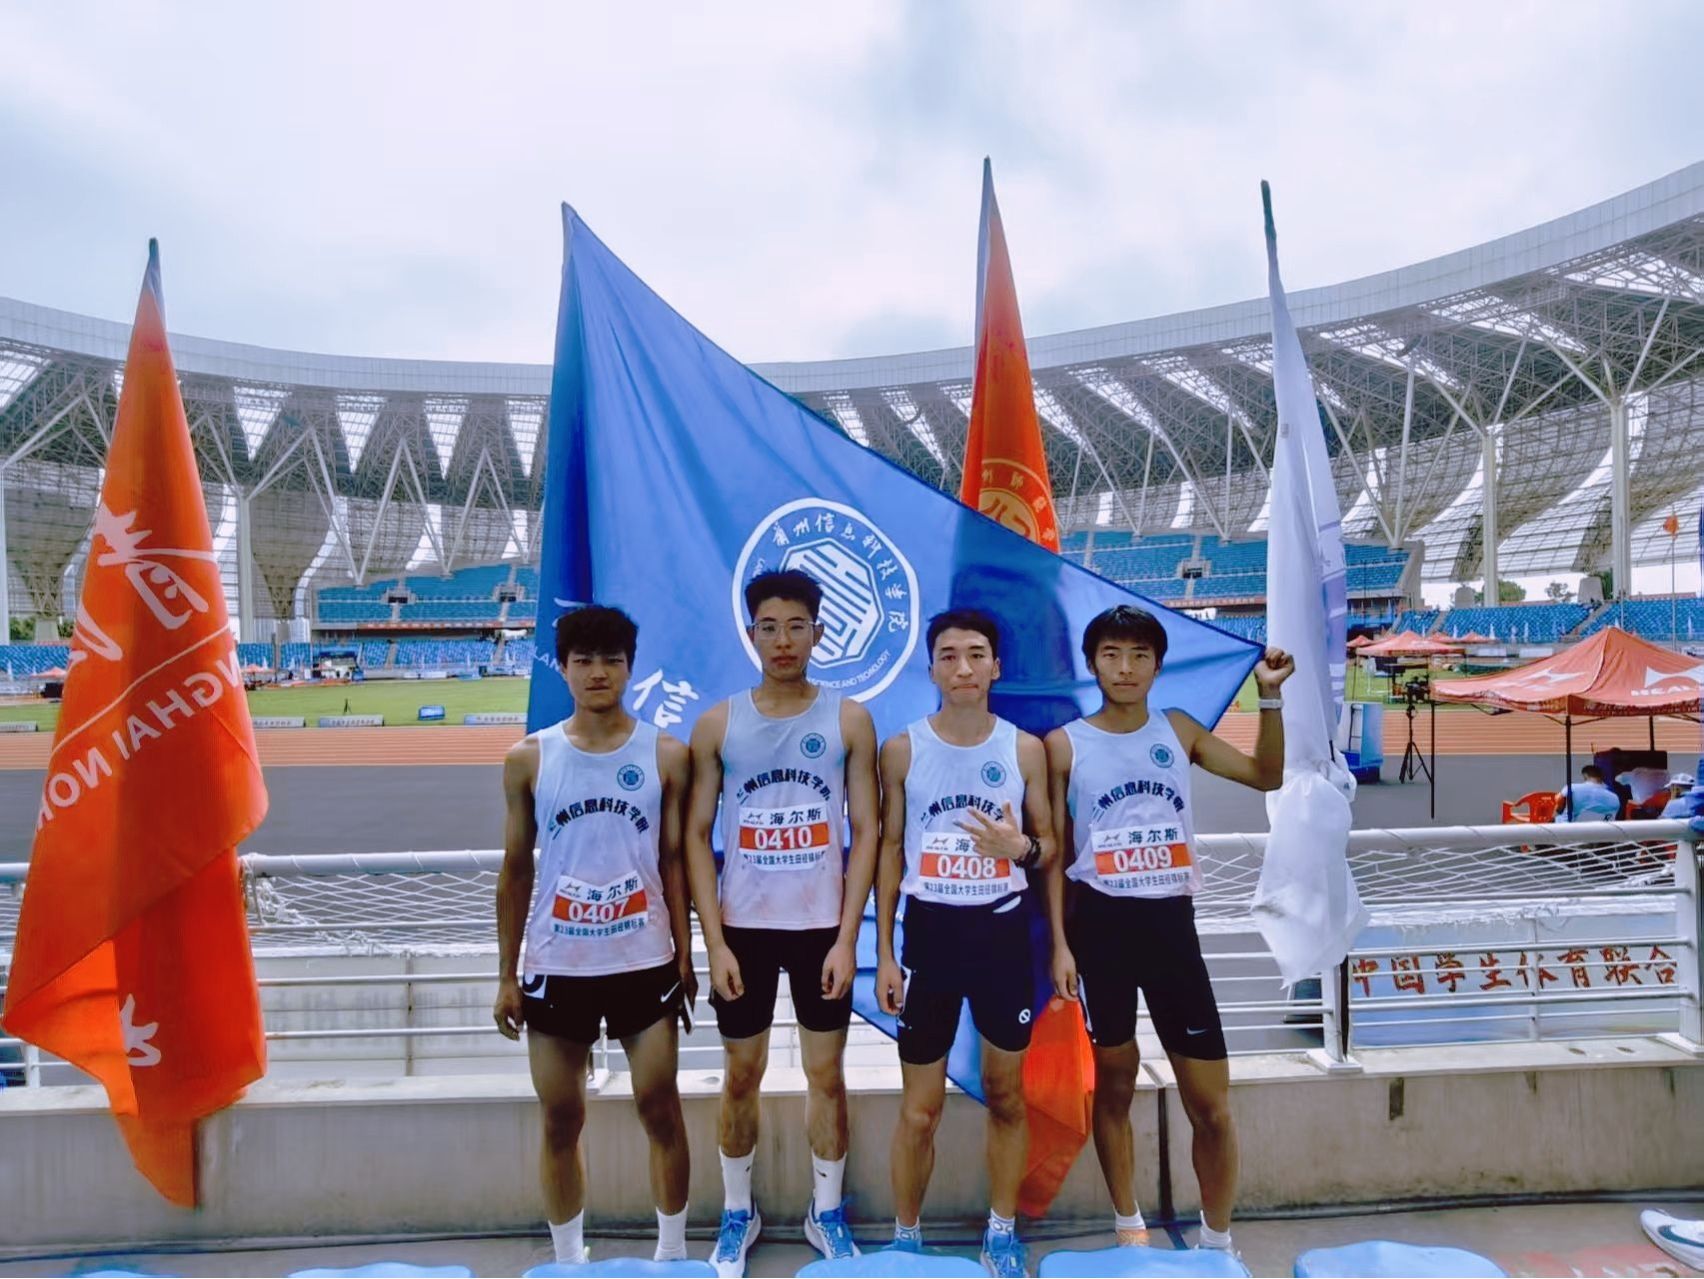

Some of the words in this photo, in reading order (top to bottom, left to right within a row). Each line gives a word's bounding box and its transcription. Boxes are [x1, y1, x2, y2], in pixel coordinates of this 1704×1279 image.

[632, 669, 700, 729] 信
[770, 808, 821, 825] 海尔斯
[755, 826, 812, 850] 0410
[1129, 827, 1178, 845] 海尔斯
[937, 855, 997, 878] 0408
[1113, 846, 1172, 873] 0409
[587, 876, 638, 902] 海尔斯
[568, 896, 629, 923] 0407
